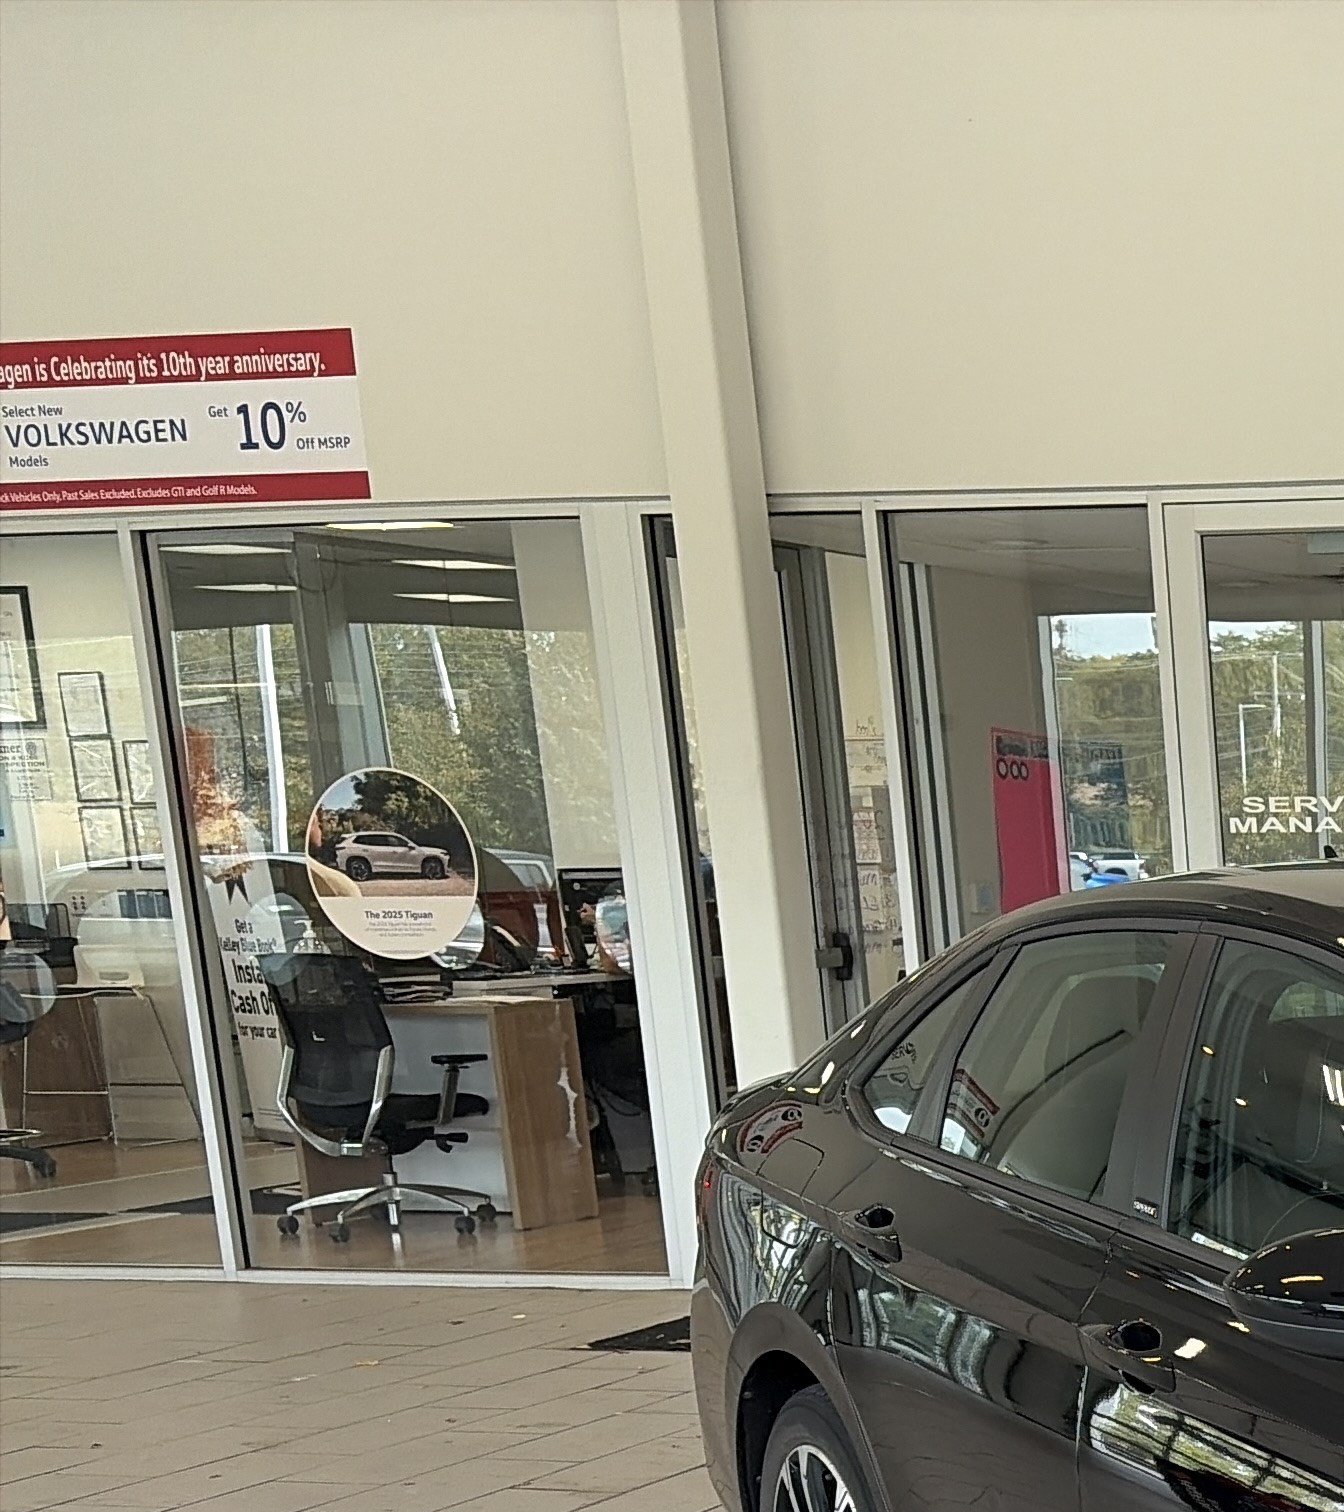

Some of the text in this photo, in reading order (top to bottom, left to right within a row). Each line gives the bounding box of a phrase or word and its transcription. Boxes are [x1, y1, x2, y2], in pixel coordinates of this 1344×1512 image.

[33, 357, 48, 382] is
[50, 354, 135, 384] Celebrating
[160, 351, 196, 377] 10th
[198, 355, 231, 381] year
[233, 347, 326, 377] anniversary.
[1, 404, 63, 418] Select New
[208, 405, 229, 418] Get
[4, 418, 188, 448] VOLKSWAGEN
[296, 436, 351, 450] Off MSRP
[8, 454, 49, 468] Models
[10, 491, 42, 503] Vehicles
[62, 490, 79, 501] Past
[79, 489, 99, 501] Sales
[137, 487, 170, 498] Excludes
[171, 486, 185, 498] GTI
[186, 486, 200, 497] and
[201, 485, 219, 496] Golf
[220, 485, 226, 495] R
[364, 910, 434, 920] The 2025 Tiguan
[234, 919, 248, 934] Get
[231, 989, 260, 1014] Cash
[238, 1021, 277, 1040] for your car
